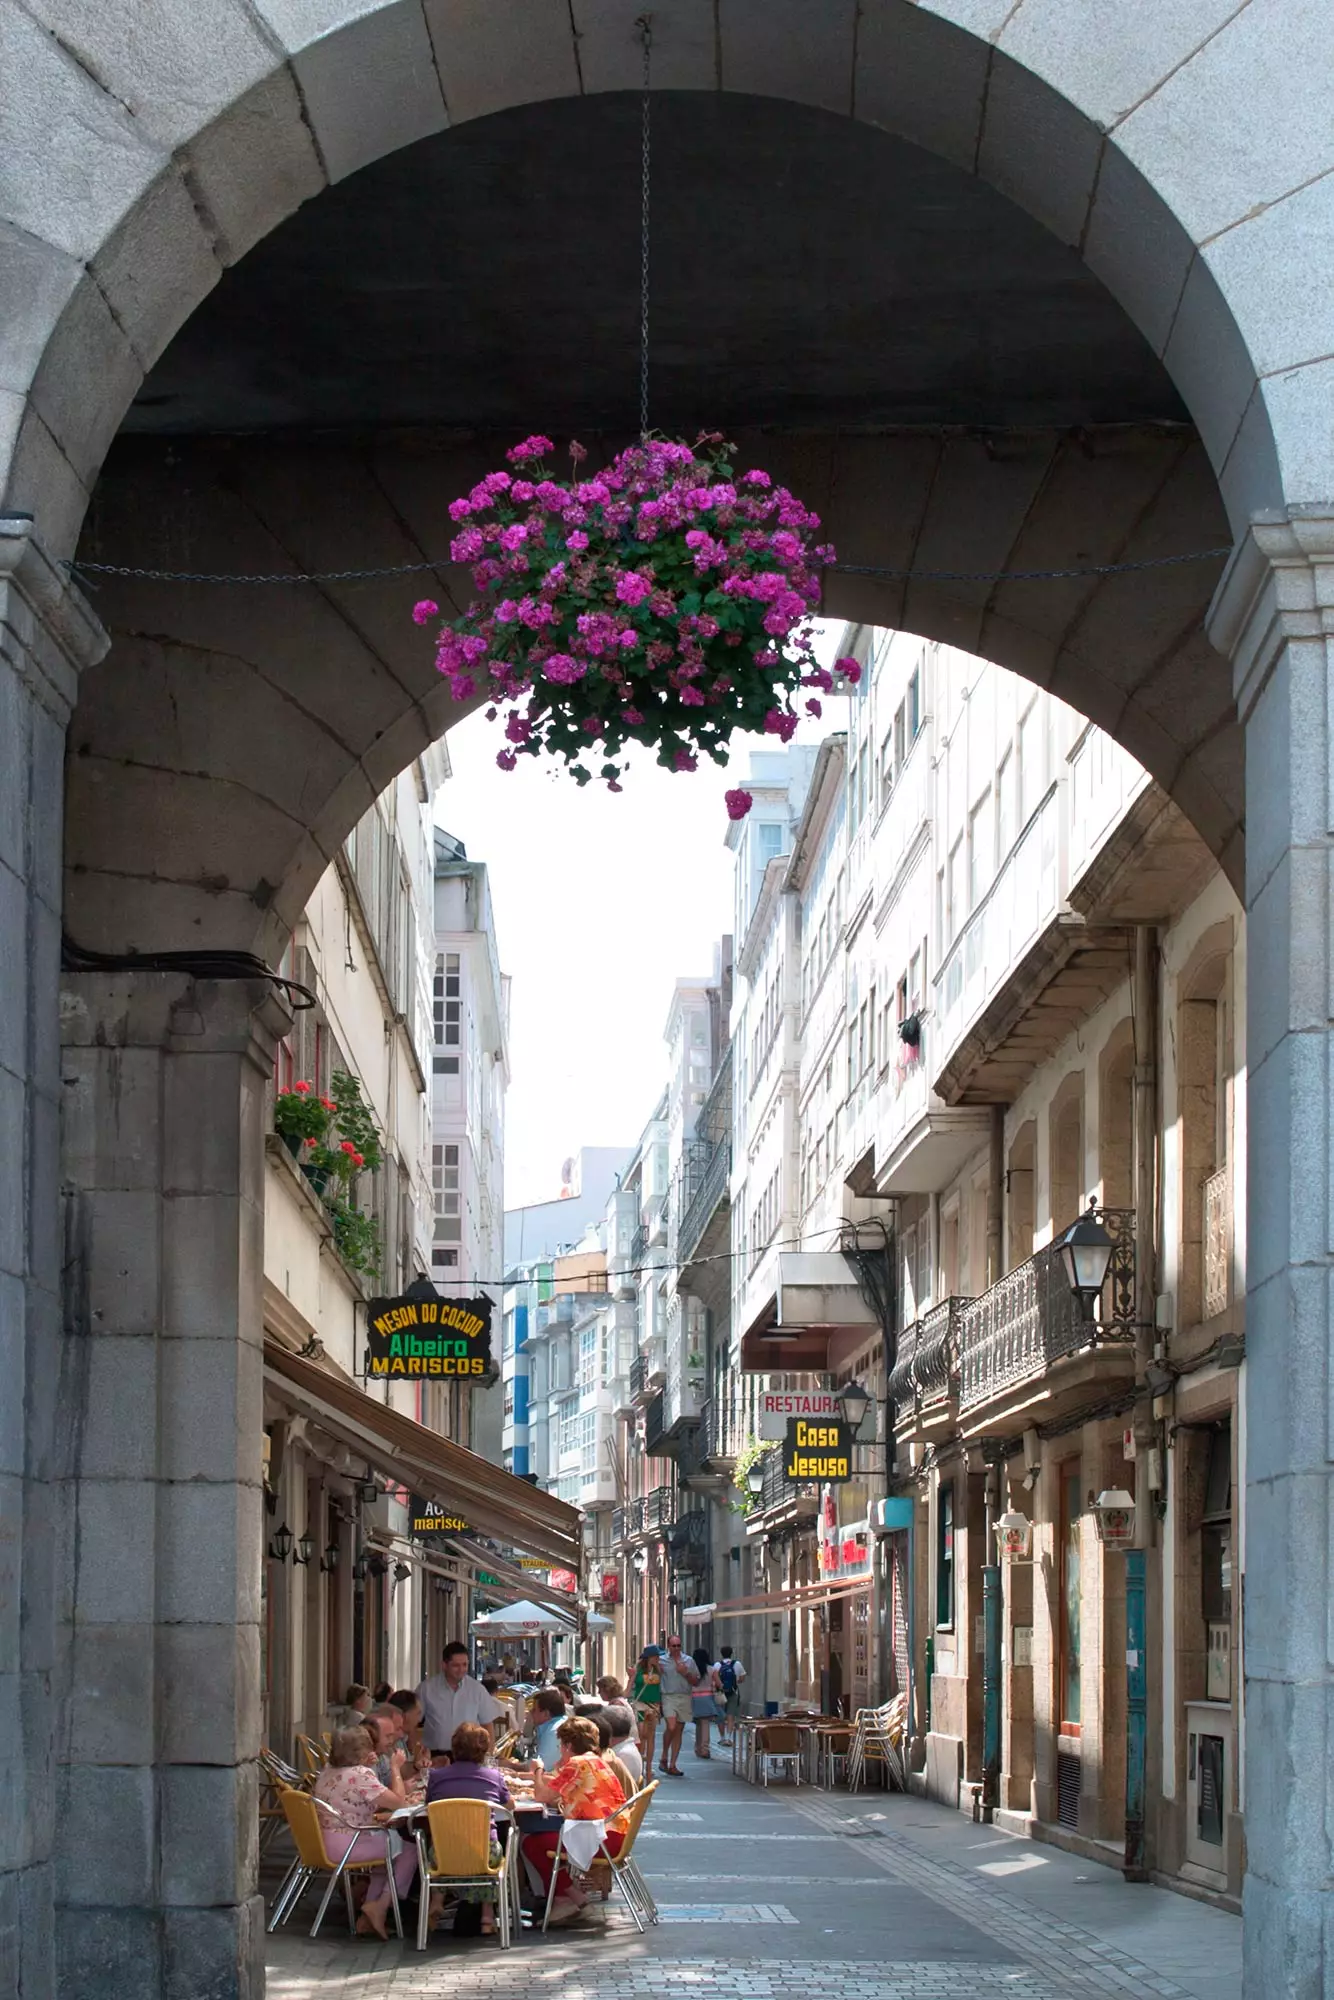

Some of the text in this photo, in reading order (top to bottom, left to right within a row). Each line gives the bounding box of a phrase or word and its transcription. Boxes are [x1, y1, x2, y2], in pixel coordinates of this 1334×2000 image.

[373, 1303, 485, 1338] MESON DO COCIDO
[389, 1334, 468, 1357] Albeiro
[372, 1357, 484, 1375] MARISCOS
[765, 1396, 872, 1413] RESTAURAE
[796, 1421, 839, 1447] Casa
[788, 1451, 848, 1477] Jesusa
